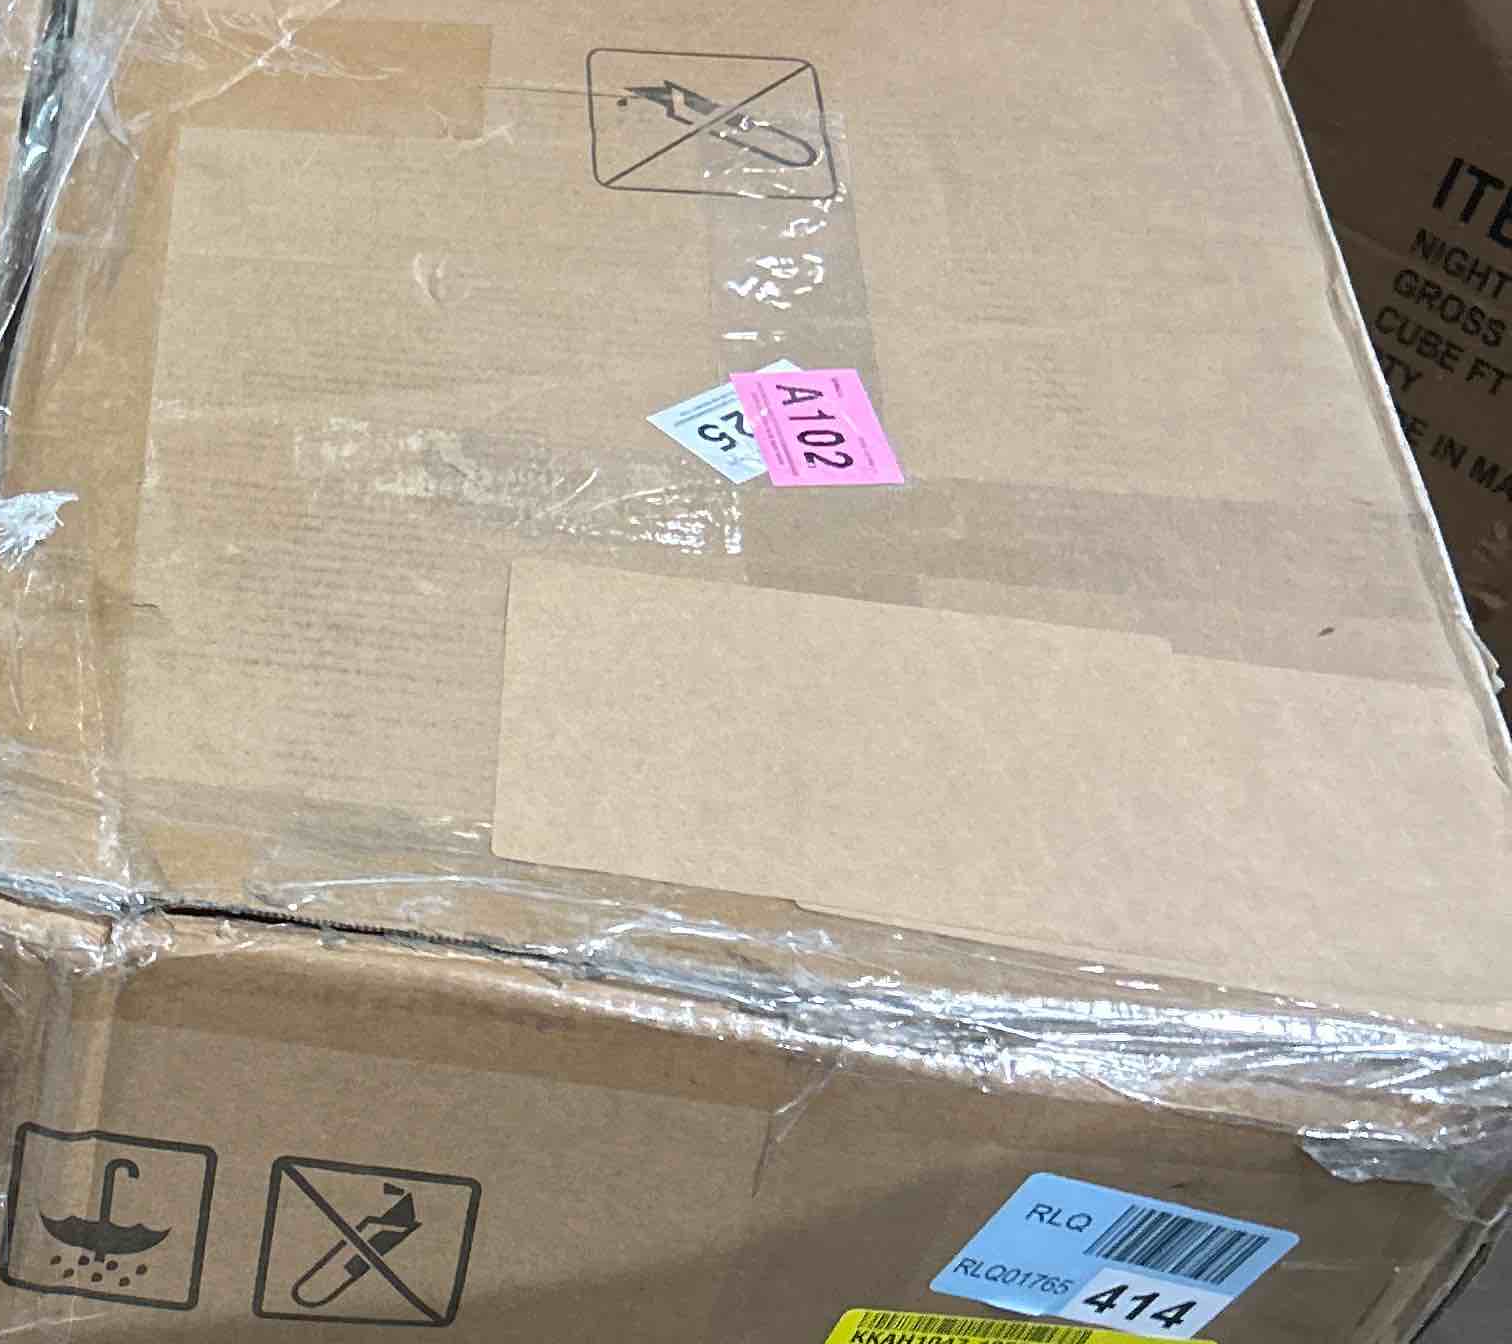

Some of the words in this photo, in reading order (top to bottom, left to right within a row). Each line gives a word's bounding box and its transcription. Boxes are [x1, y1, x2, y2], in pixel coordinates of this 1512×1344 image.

[1392, 267, 1507, 349] GROSS
[1374, 305, 1466, 375] CUBE
[775, 382, 855, 470] A102
[1432, 433, 1470, 471] IN
[1024, 1202, 1093, 1234] RLQ
[952, 1256, 1077, 1297] RLQ01765
[1082, 1283, 1197, 1330] 414
